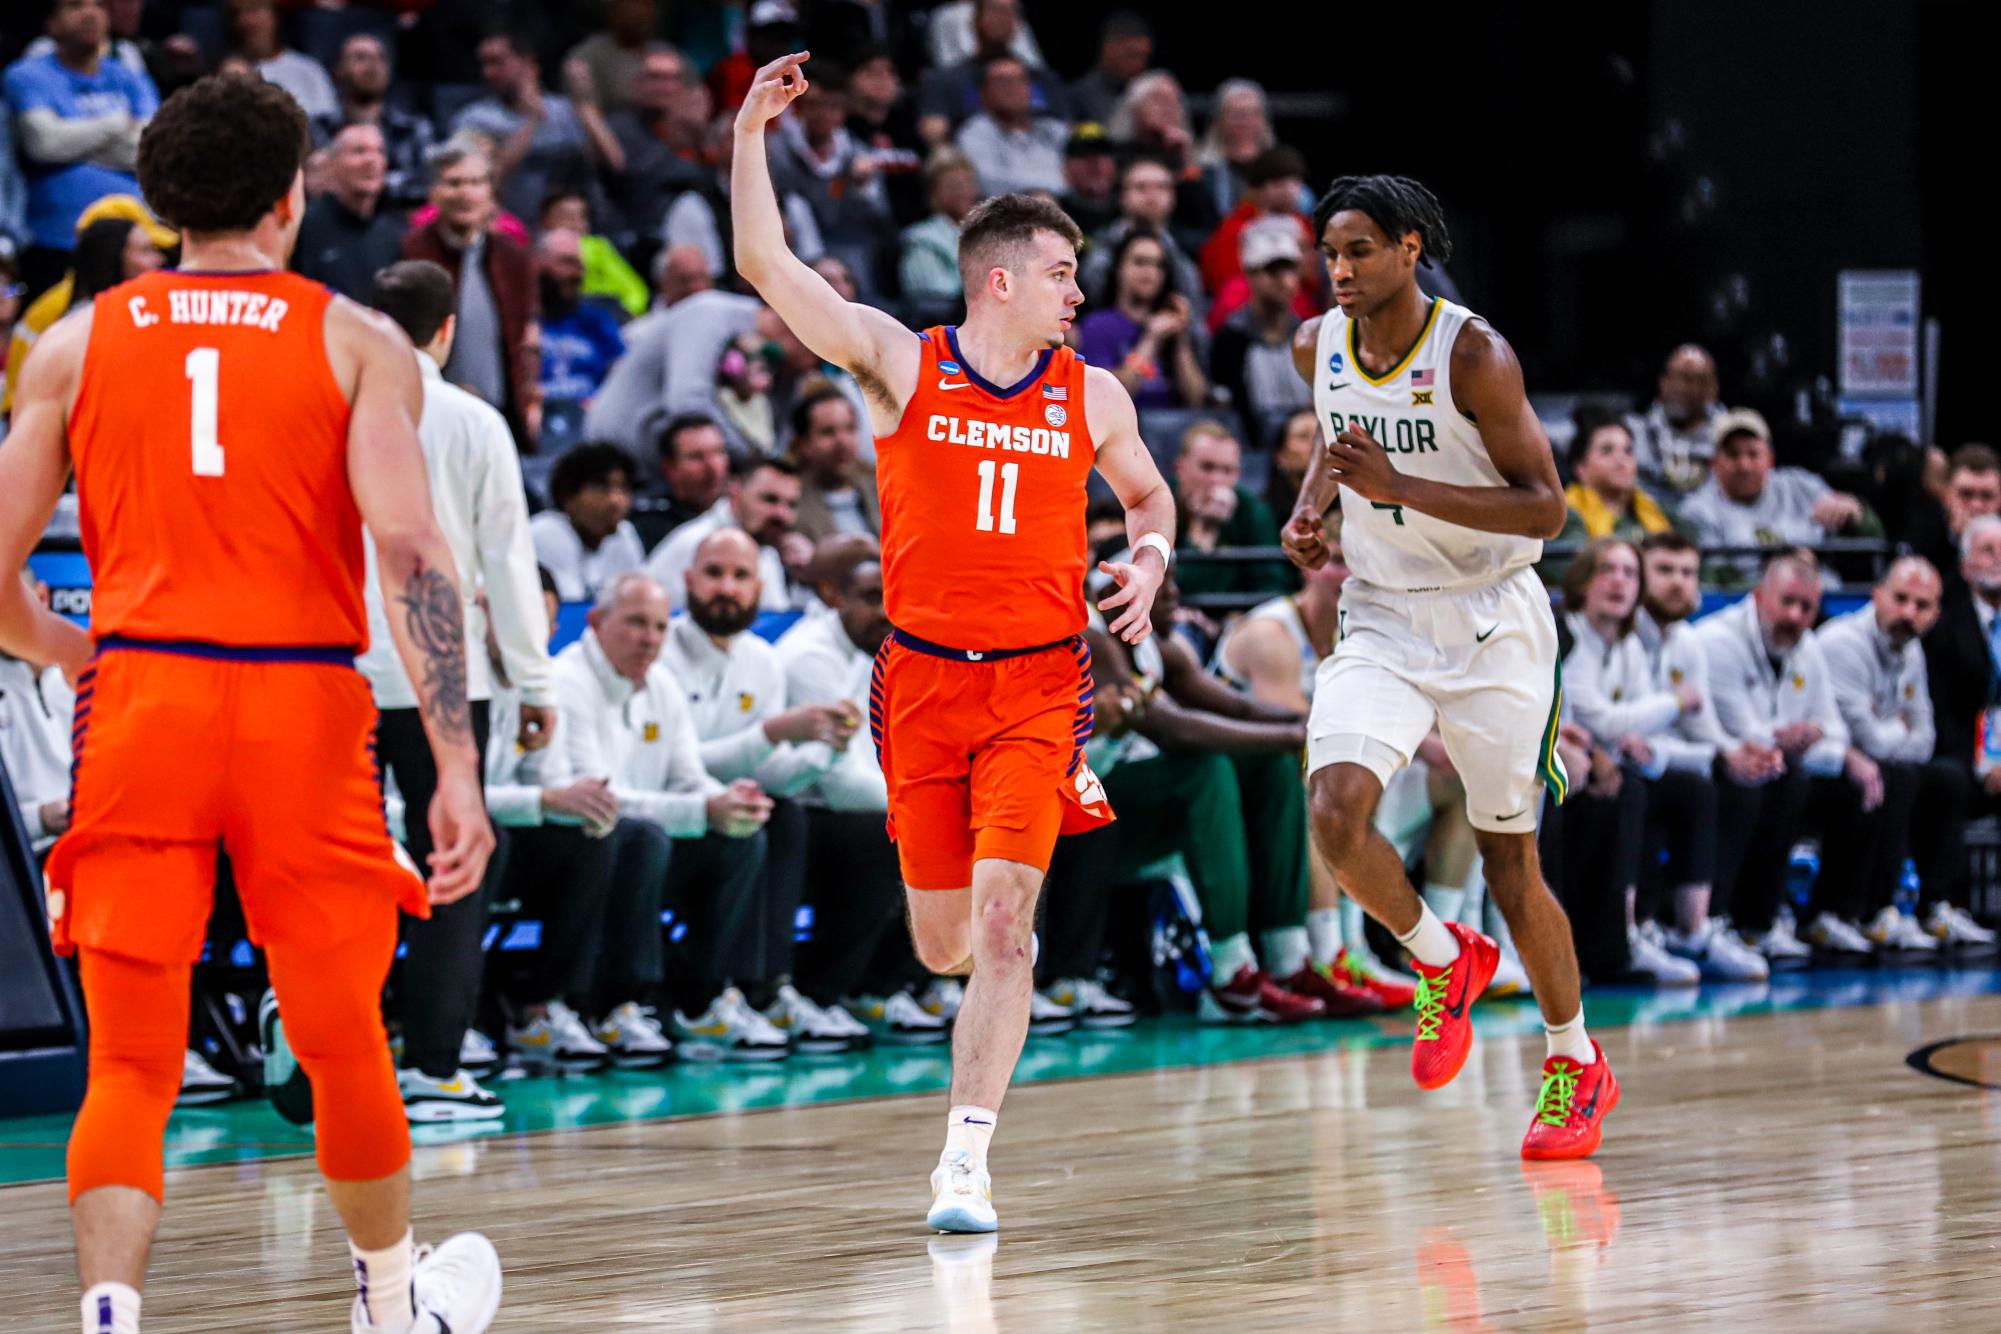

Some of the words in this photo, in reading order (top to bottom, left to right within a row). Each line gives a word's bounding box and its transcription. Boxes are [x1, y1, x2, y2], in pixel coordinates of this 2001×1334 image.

[128, 296, 159, 328] C.
[168, 289, 288, 332] HUNTER
[185, 347, 225, 477] 1
[1330, 412, 1439, 453] BYLOR
[927, 414, 1070, 459] CLEMSON
[976, 460, 1019, 535] 11
